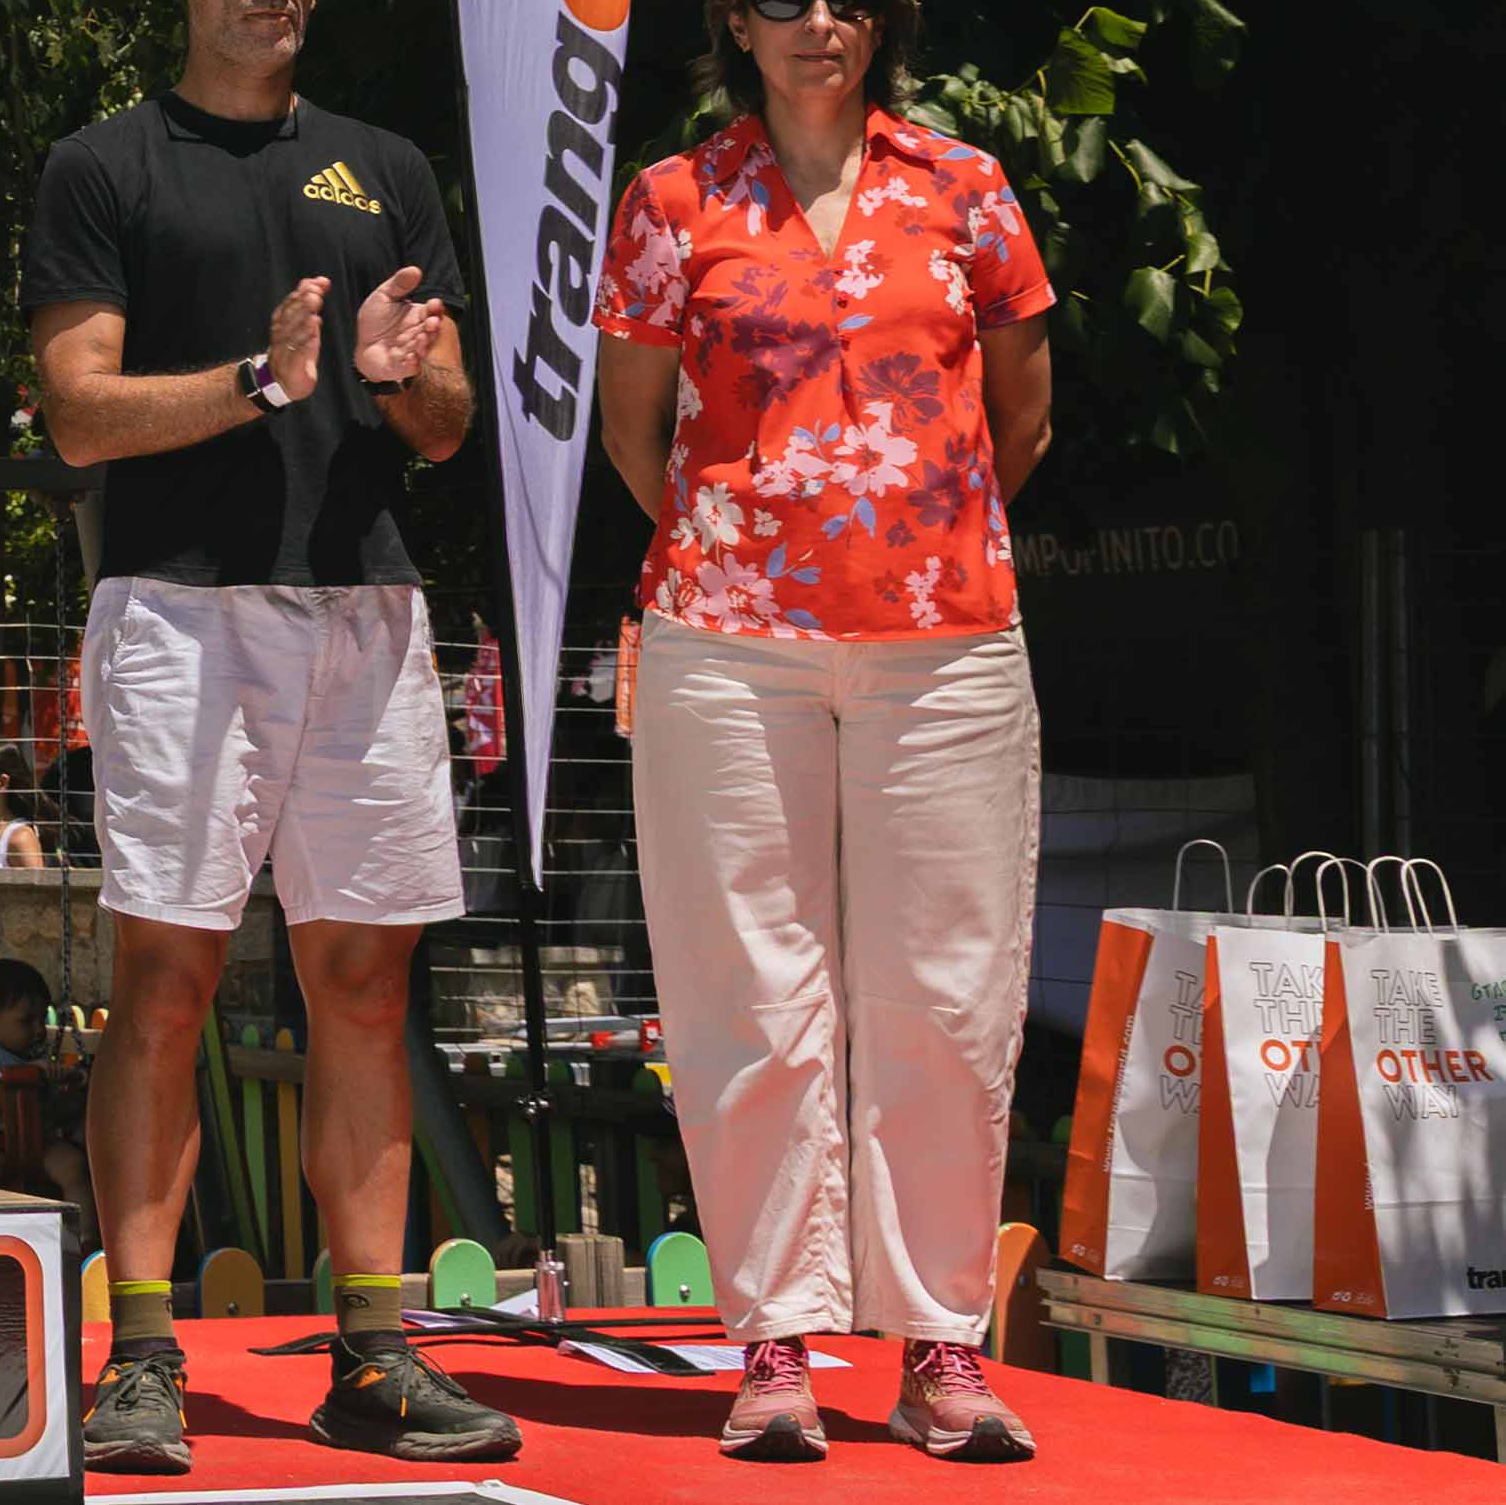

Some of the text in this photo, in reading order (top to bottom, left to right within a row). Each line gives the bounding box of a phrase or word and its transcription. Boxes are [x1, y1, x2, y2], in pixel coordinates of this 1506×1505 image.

[302, 180, 382, 215] adidas
[1249, 961, 1324, 999] TAK
[1370, 969, 1443, 1007] TAKE
[1373, 1007, 1437, 1044] THE
[1376, 1049, 1494, 1083] OTHER
[1383, 1084, 1459, 1120] WAY
